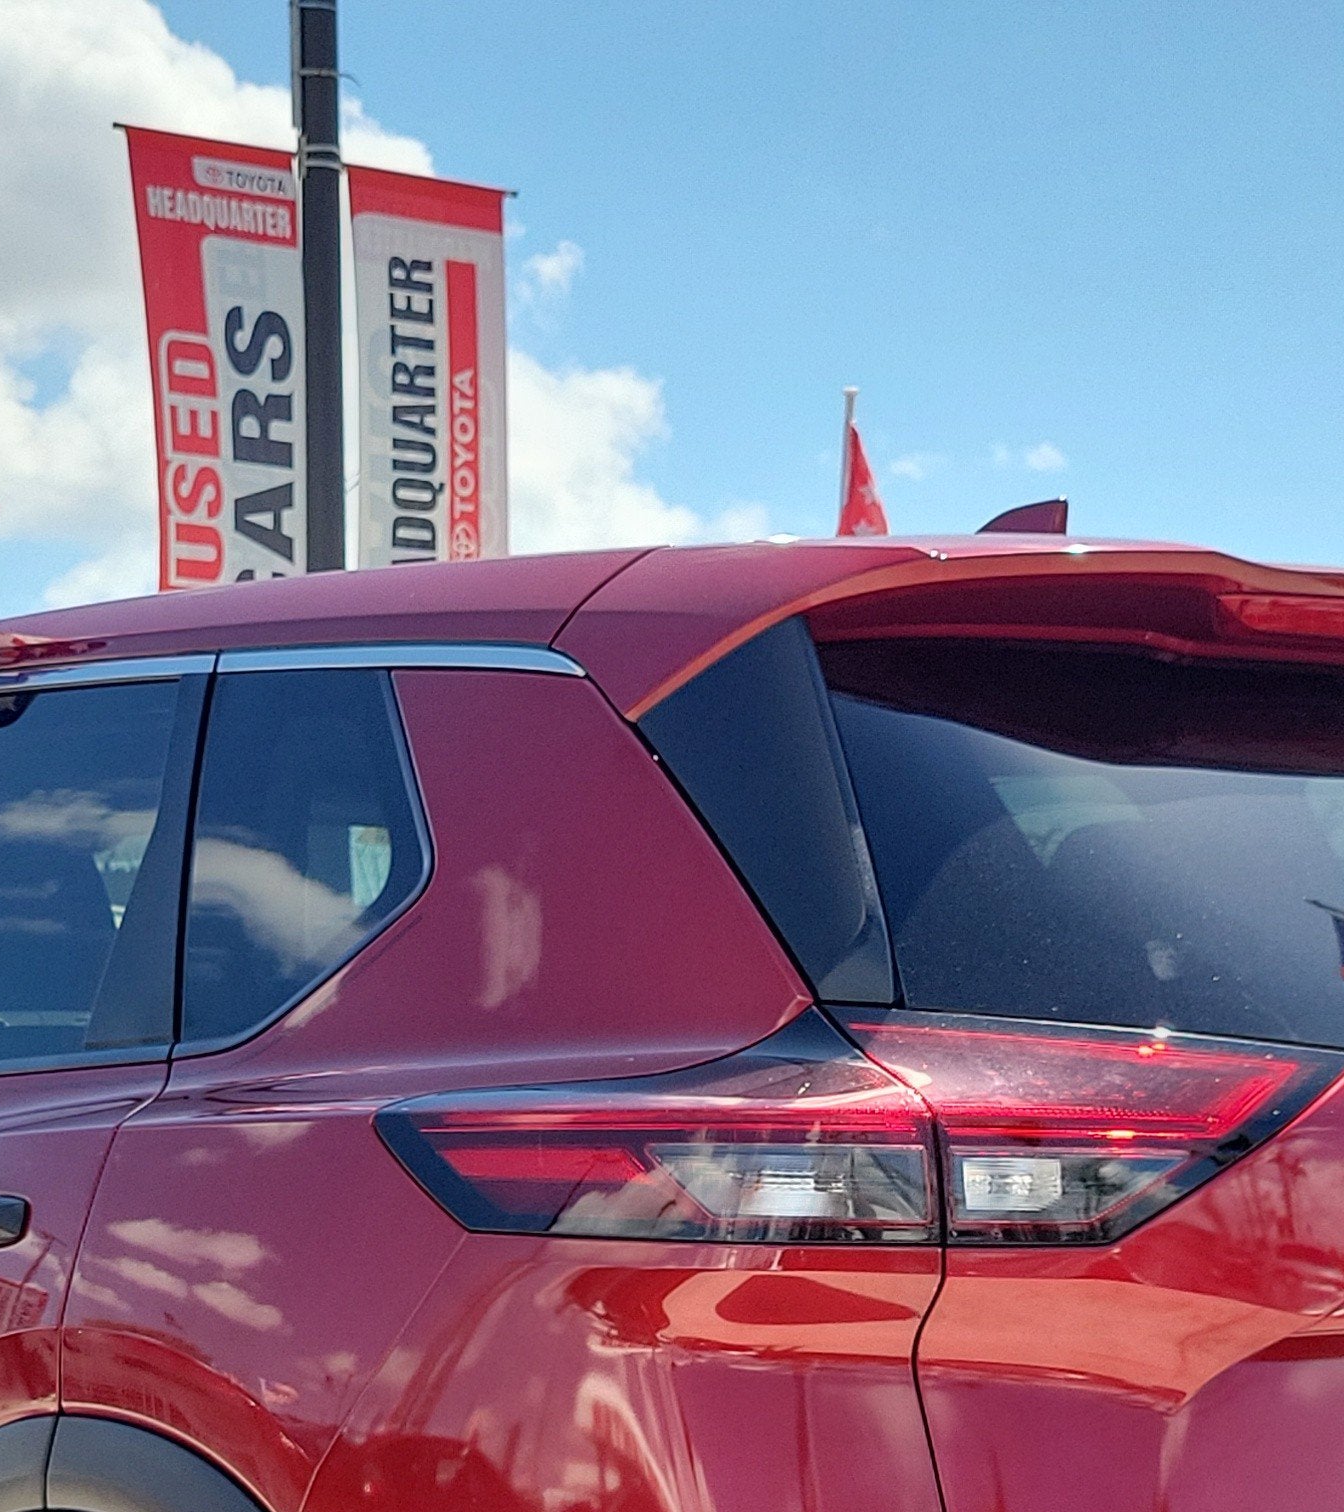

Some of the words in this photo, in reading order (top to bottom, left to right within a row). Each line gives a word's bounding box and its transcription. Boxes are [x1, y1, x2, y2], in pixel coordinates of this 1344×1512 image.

[146, 185, 292, 239] HEADQUARTER
[226, 171, 287, 195] TOYOTA
[166, 339, 225, 583] USED
[389, 256, 445, 565] DQUARTER
[452, 368, 477, 520] TOYOTA
